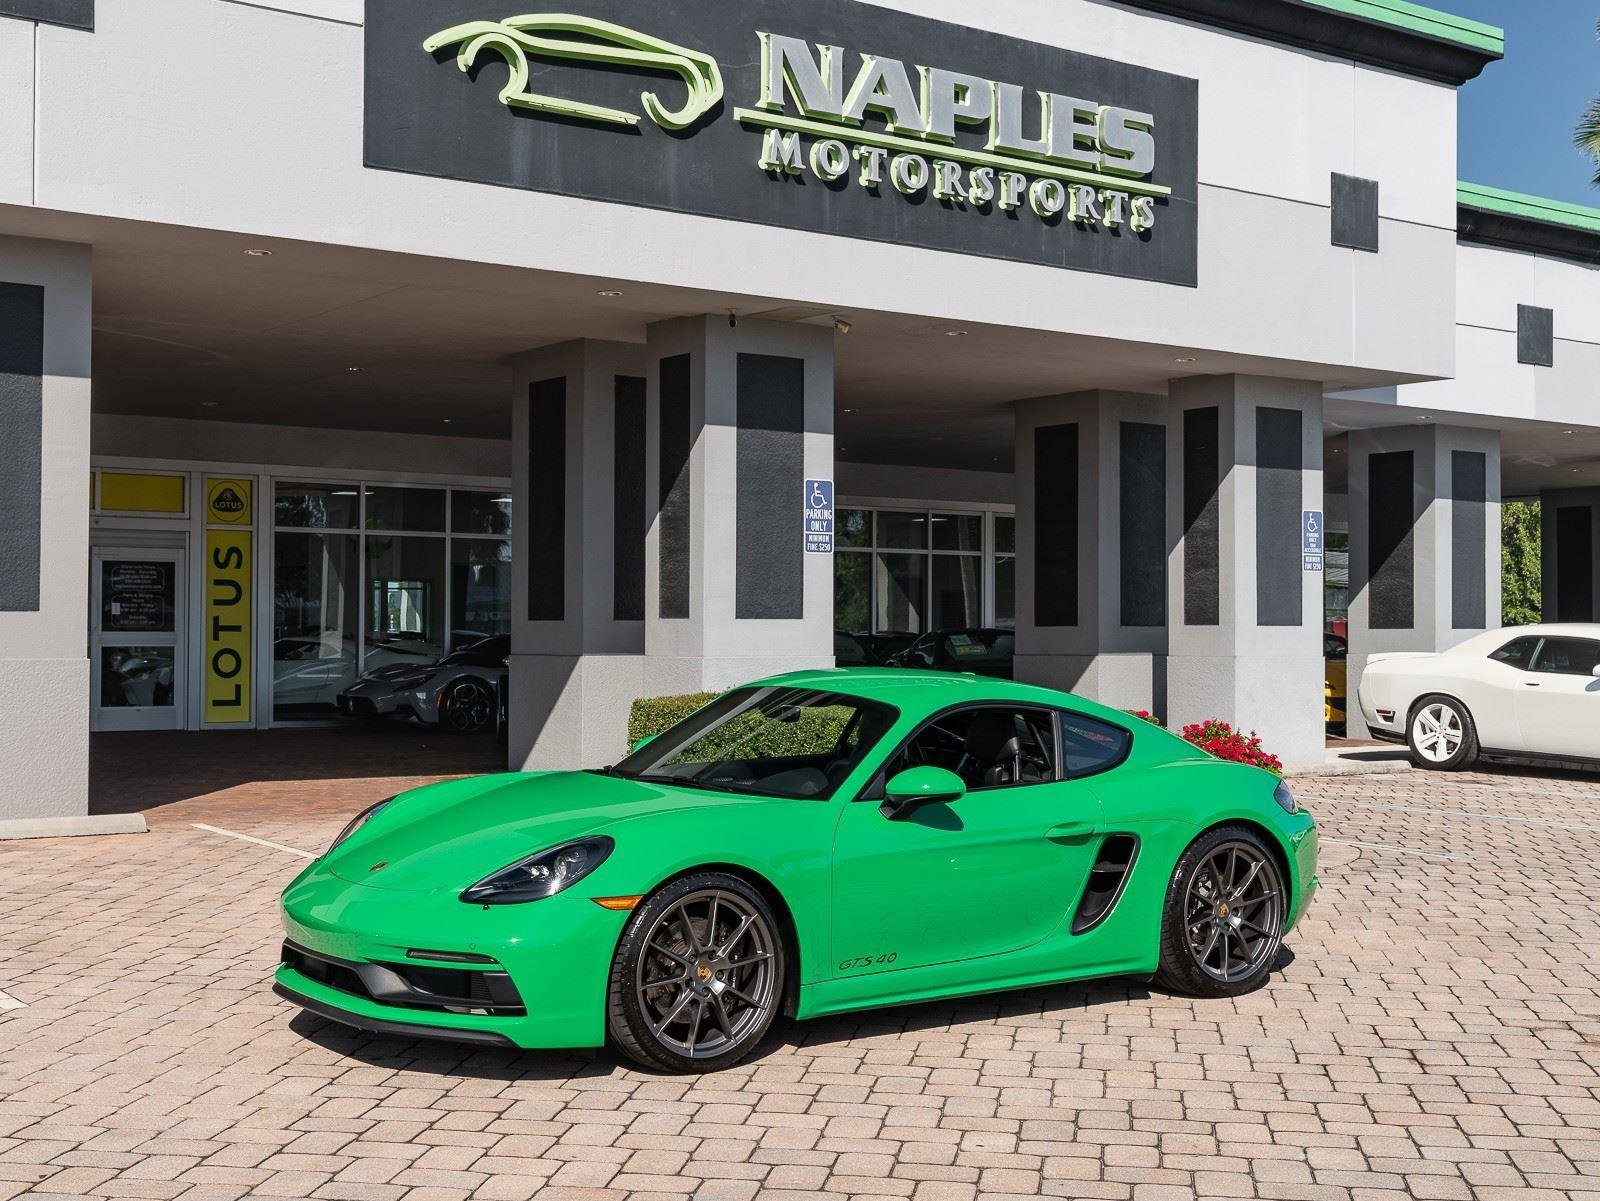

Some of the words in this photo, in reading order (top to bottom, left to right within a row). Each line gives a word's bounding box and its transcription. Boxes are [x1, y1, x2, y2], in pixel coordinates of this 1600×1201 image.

[756, 30, 1155, 178] NAPLES
[758, 128, 1155, 233] MOTORSPORTS
[214, 501, 242, 509] LOTUS
[806, 509, 832, 519] PARKING
[810, 520, 827, 531] ONLY
[807, 543, 818, 551] FINE
[818, 543, 831, 552] $250
[211, 545, 243, 707] LOTUS
[839, 955, 874, 971] GTS
